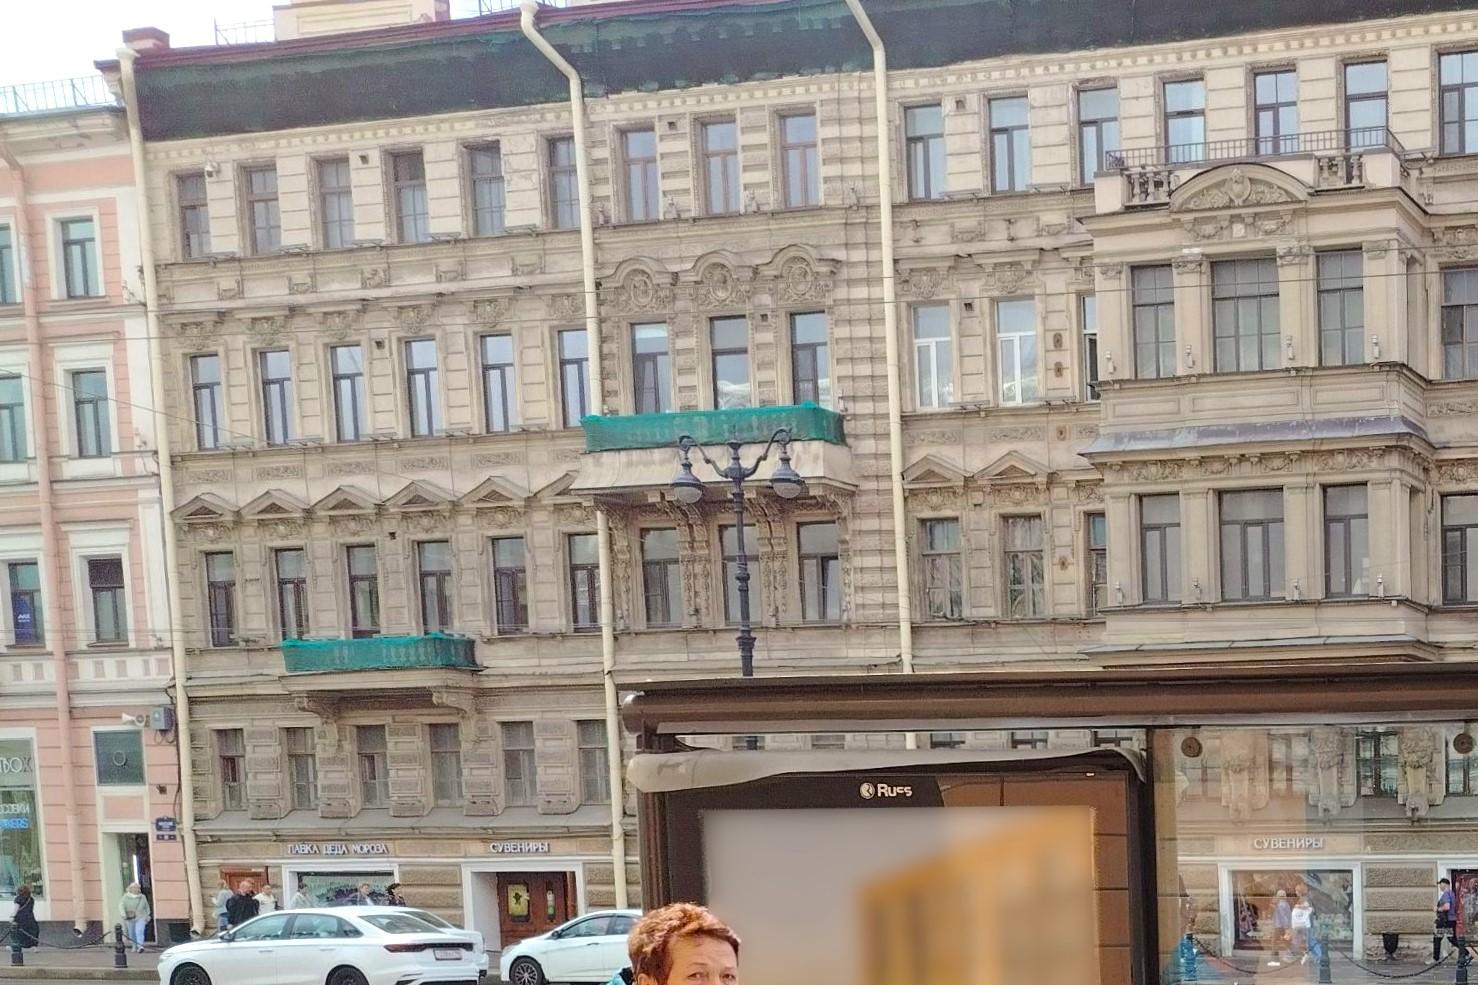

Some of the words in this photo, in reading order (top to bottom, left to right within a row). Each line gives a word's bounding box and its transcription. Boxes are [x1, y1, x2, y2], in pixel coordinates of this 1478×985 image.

[288, 842, 319, 854] ЛАВКА
[323, 843, 348, 855] ДЕДА
[351, 843, 389, 854] МОРОЗА
[489, 842, 550, 854] СУВЕНИРЫ
[1253, 838, 1325, 849] СУВЕНИРЫ
